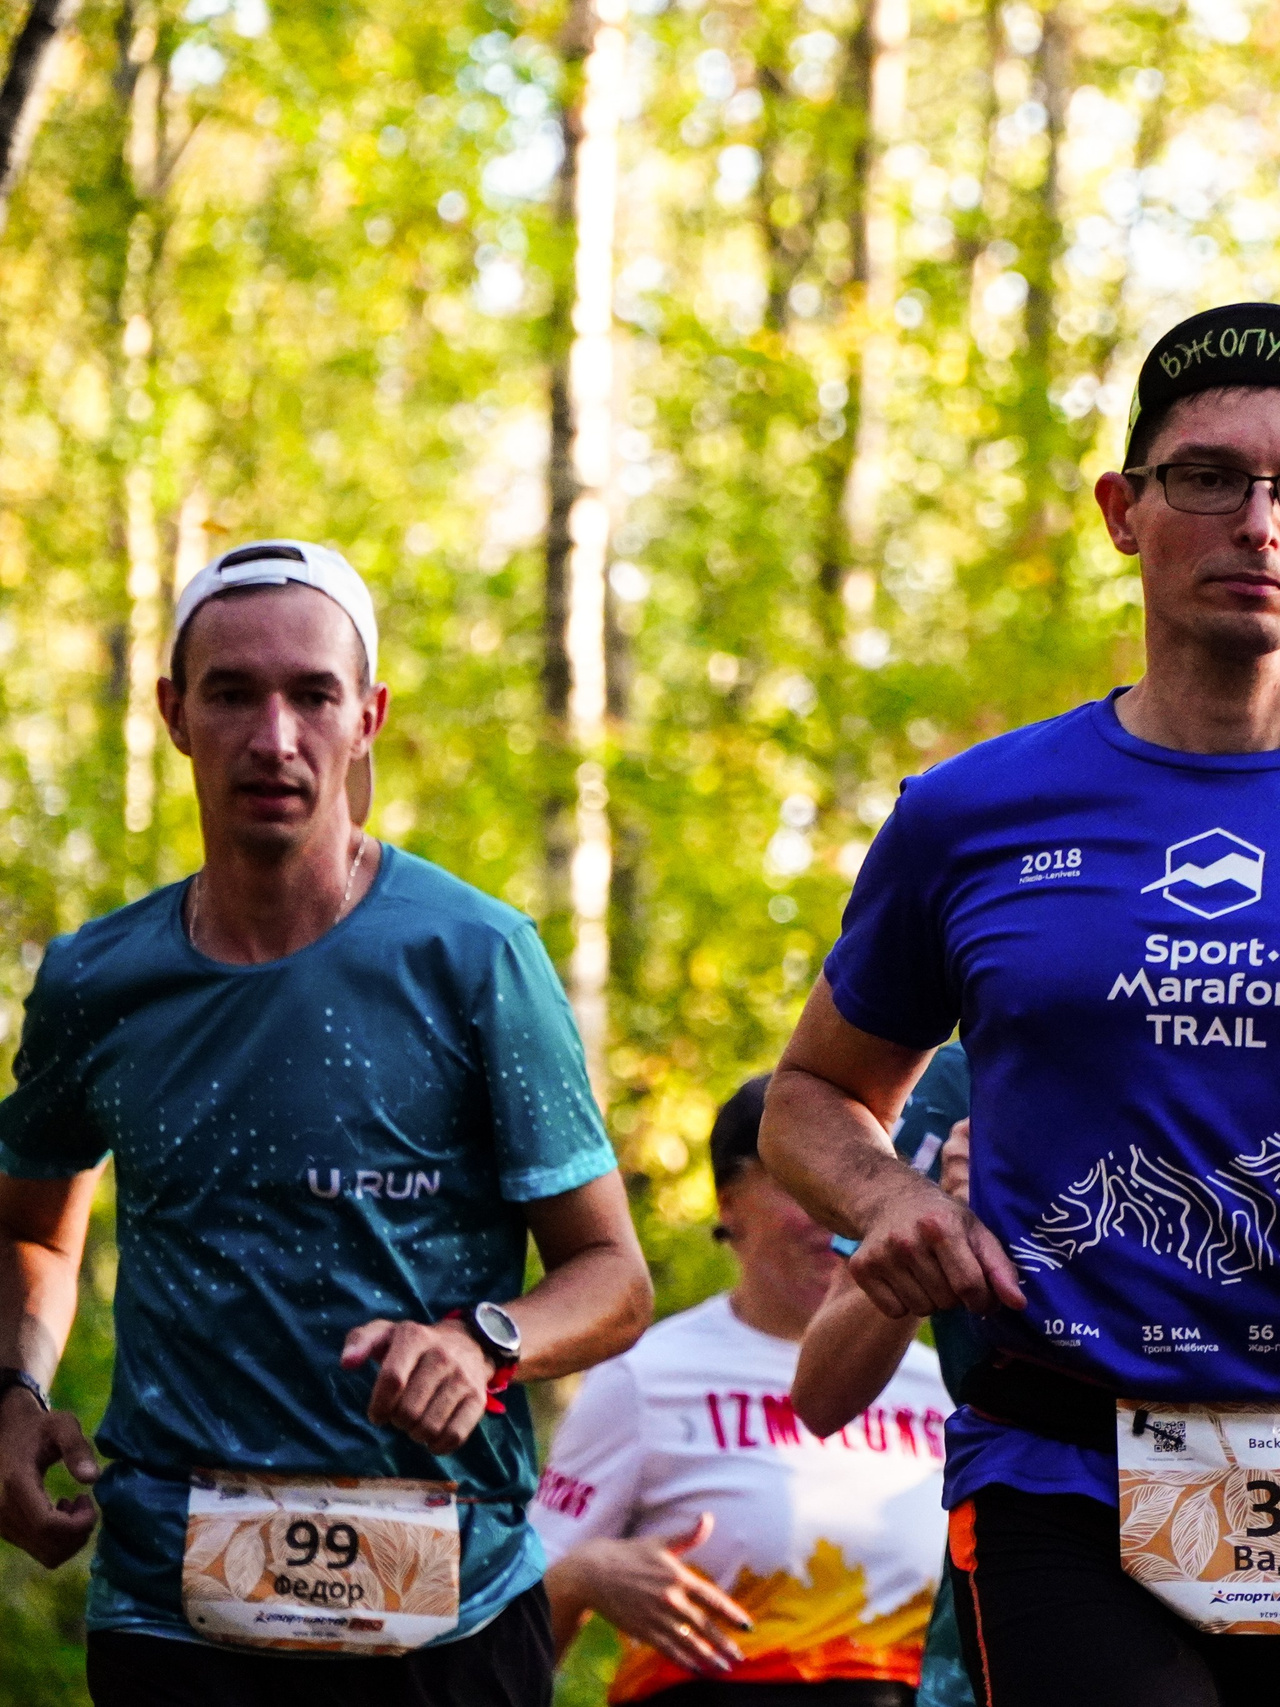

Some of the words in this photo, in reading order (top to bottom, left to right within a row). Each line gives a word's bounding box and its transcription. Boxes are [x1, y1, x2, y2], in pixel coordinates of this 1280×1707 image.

[1020, 848, 1082, 874] 2018
[1146, 1014, 1267, 1048] TRAIL
[307, 1168, 340, 1198] U
[355, 1169, 440, 1199] RUN
[1044, 1319, 1065, 1335] 10
[1142, 1325, 1164, 1341] 35
[1248, 1324, 1274, 1340] 56
[286, 1520, 359, 1570] 99
[274, 1574, 364, 1607] Федор
